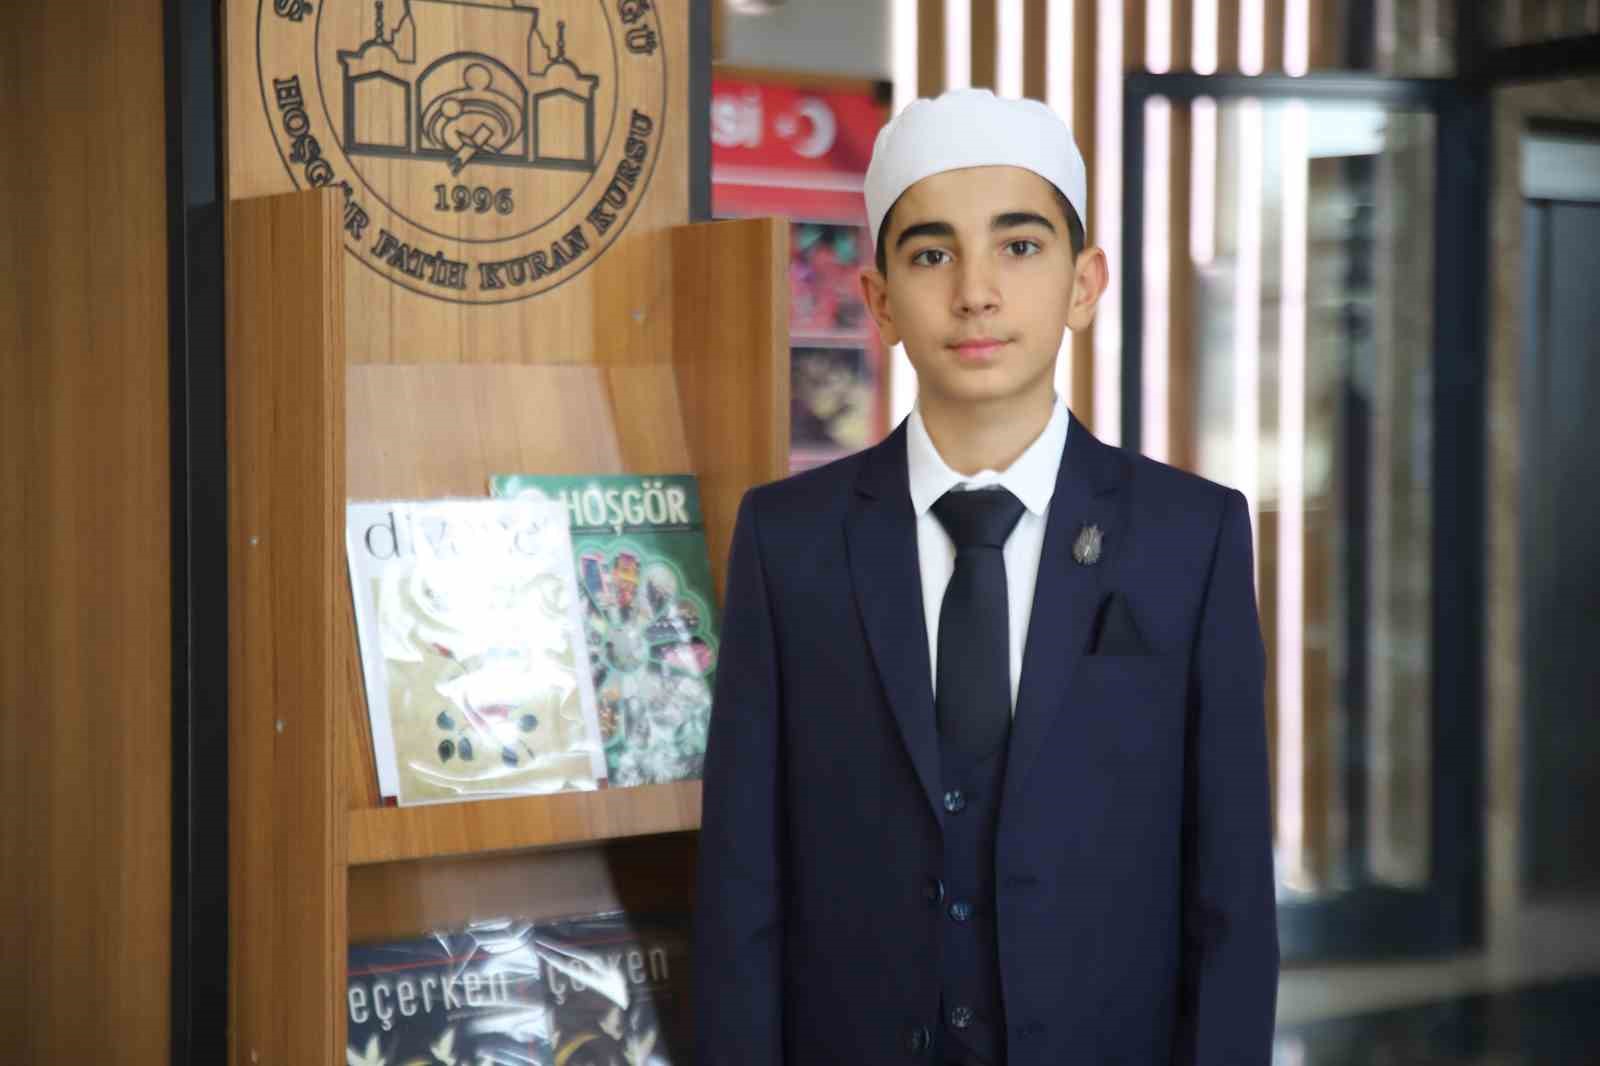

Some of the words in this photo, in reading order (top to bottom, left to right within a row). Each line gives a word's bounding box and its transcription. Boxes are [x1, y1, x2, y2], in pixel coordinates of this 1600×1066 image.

[273, 75, 370, 240] HOŞGR
[370, 229, 469, 290] FATİH
[477, 225, 589, 290] KURAN
[585, 109, 653, 238] KURSU
[433, 184, 513, 215] 1996
[560, 481, 690, 535] HOŞGÖR
